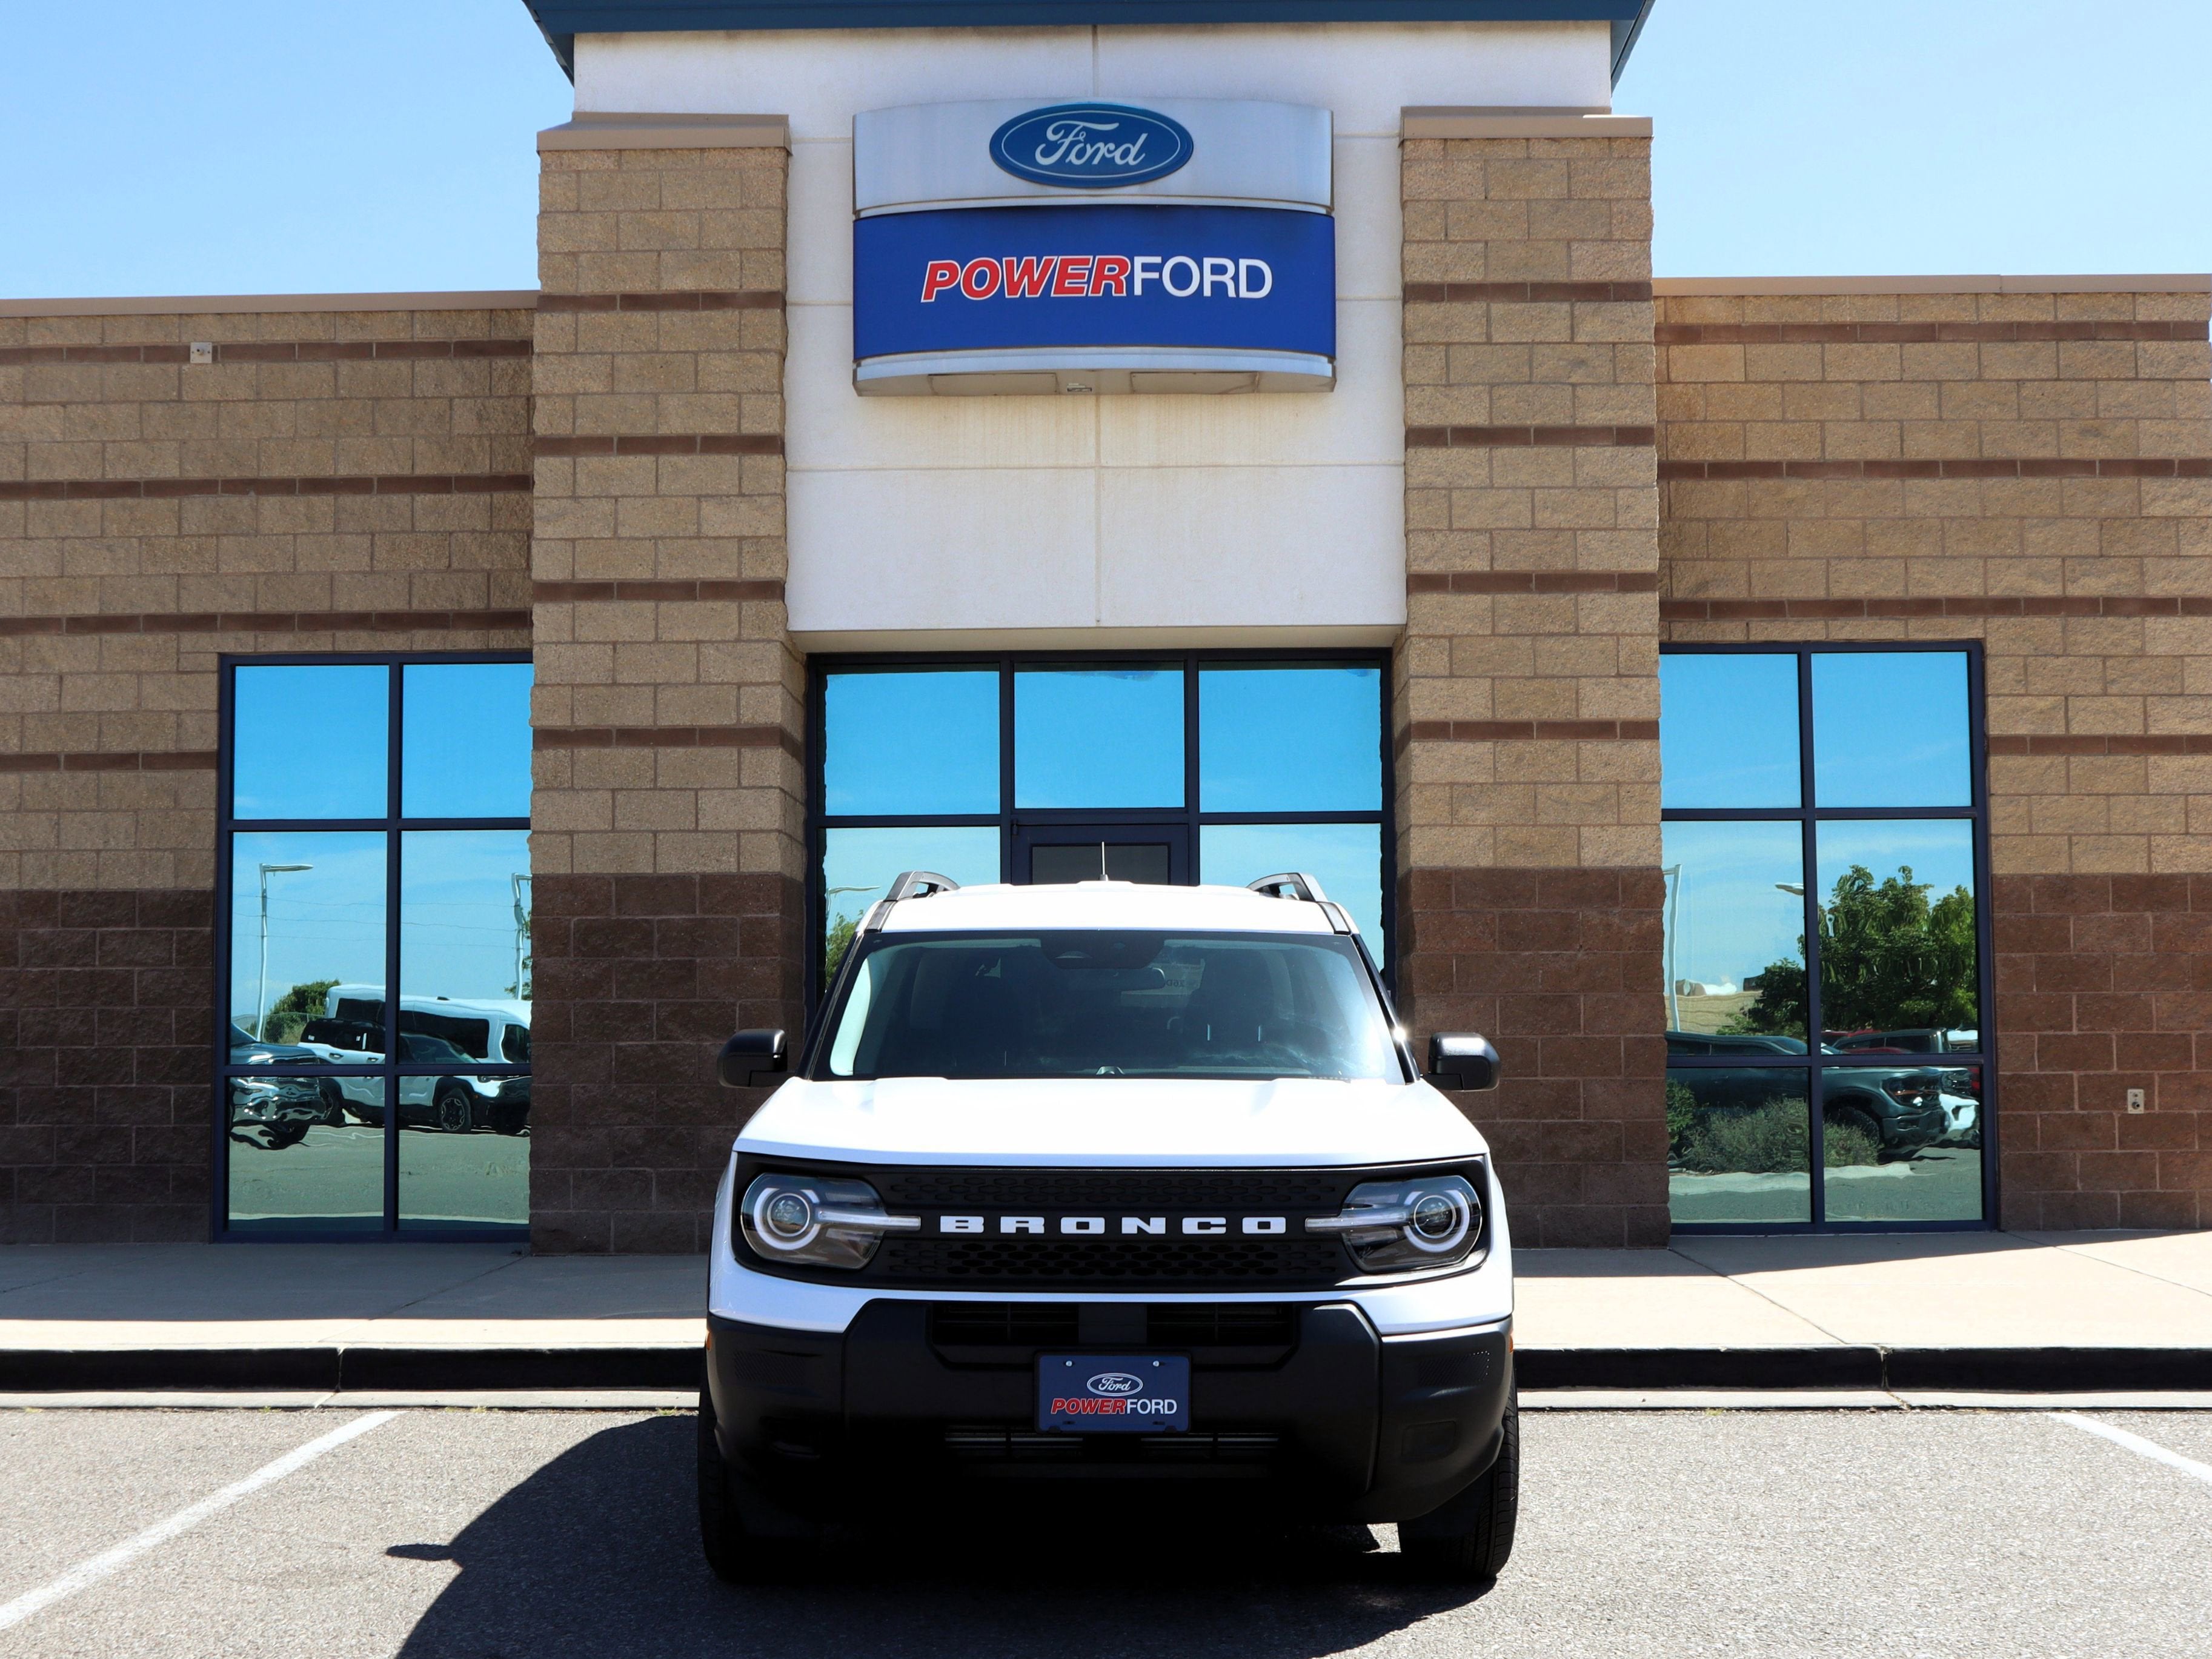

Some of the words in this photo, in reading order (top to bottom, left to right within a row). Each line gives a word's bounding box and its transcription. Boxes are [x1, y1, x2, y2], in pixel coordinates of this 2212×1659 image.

[1035, 120, 1148, 165] Ford
[920, 254, 1273, 303] POWERFORD
[940, 1215, 1286, 1234] BRONCO
[1098, 1377, 1132, 1391] Ford
[1051, 1397, 1178, 1415] POWERFORD
